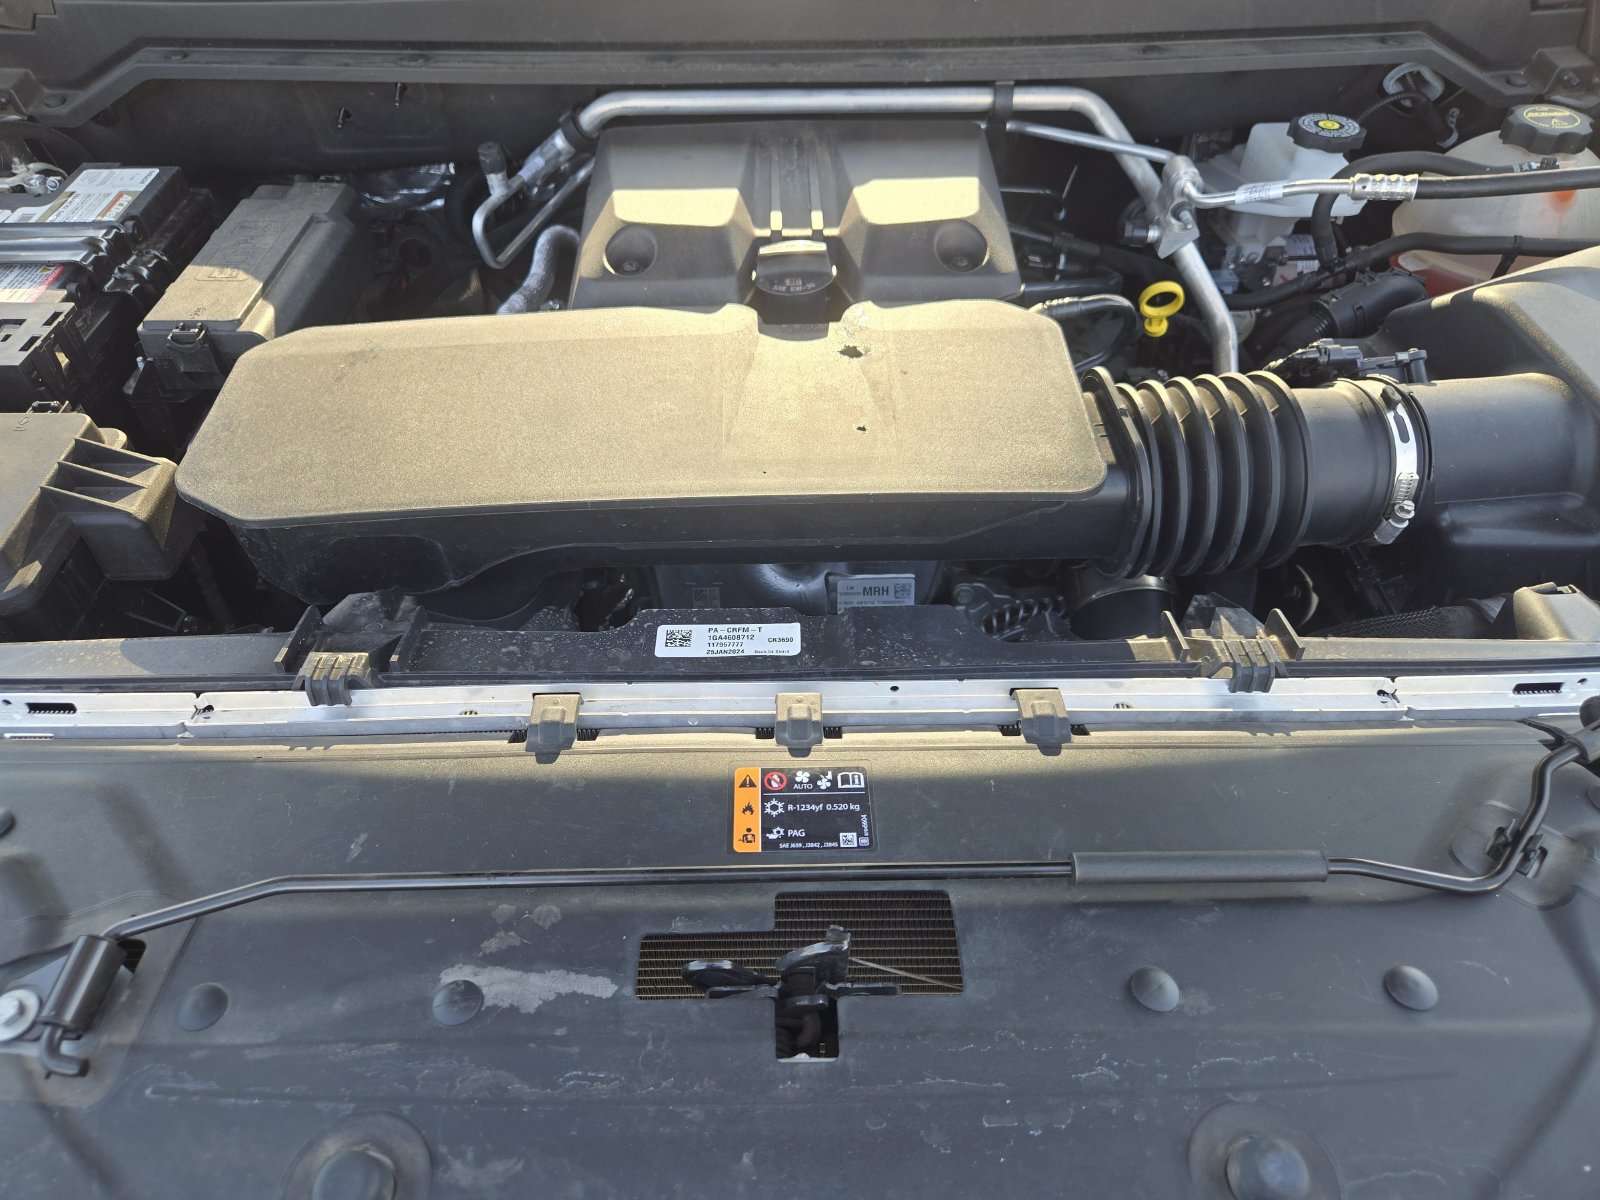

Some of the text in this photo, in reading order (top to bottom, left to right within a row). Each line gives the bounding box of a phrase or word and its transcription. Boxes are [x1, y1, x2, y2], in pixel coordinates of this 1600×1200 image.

[862, 586, 889, 597] MRH
[787, 804, 823, 813] R-1234yf
[850, 803, 860, 812] kg
[787, 829, 806, 837] PAG
